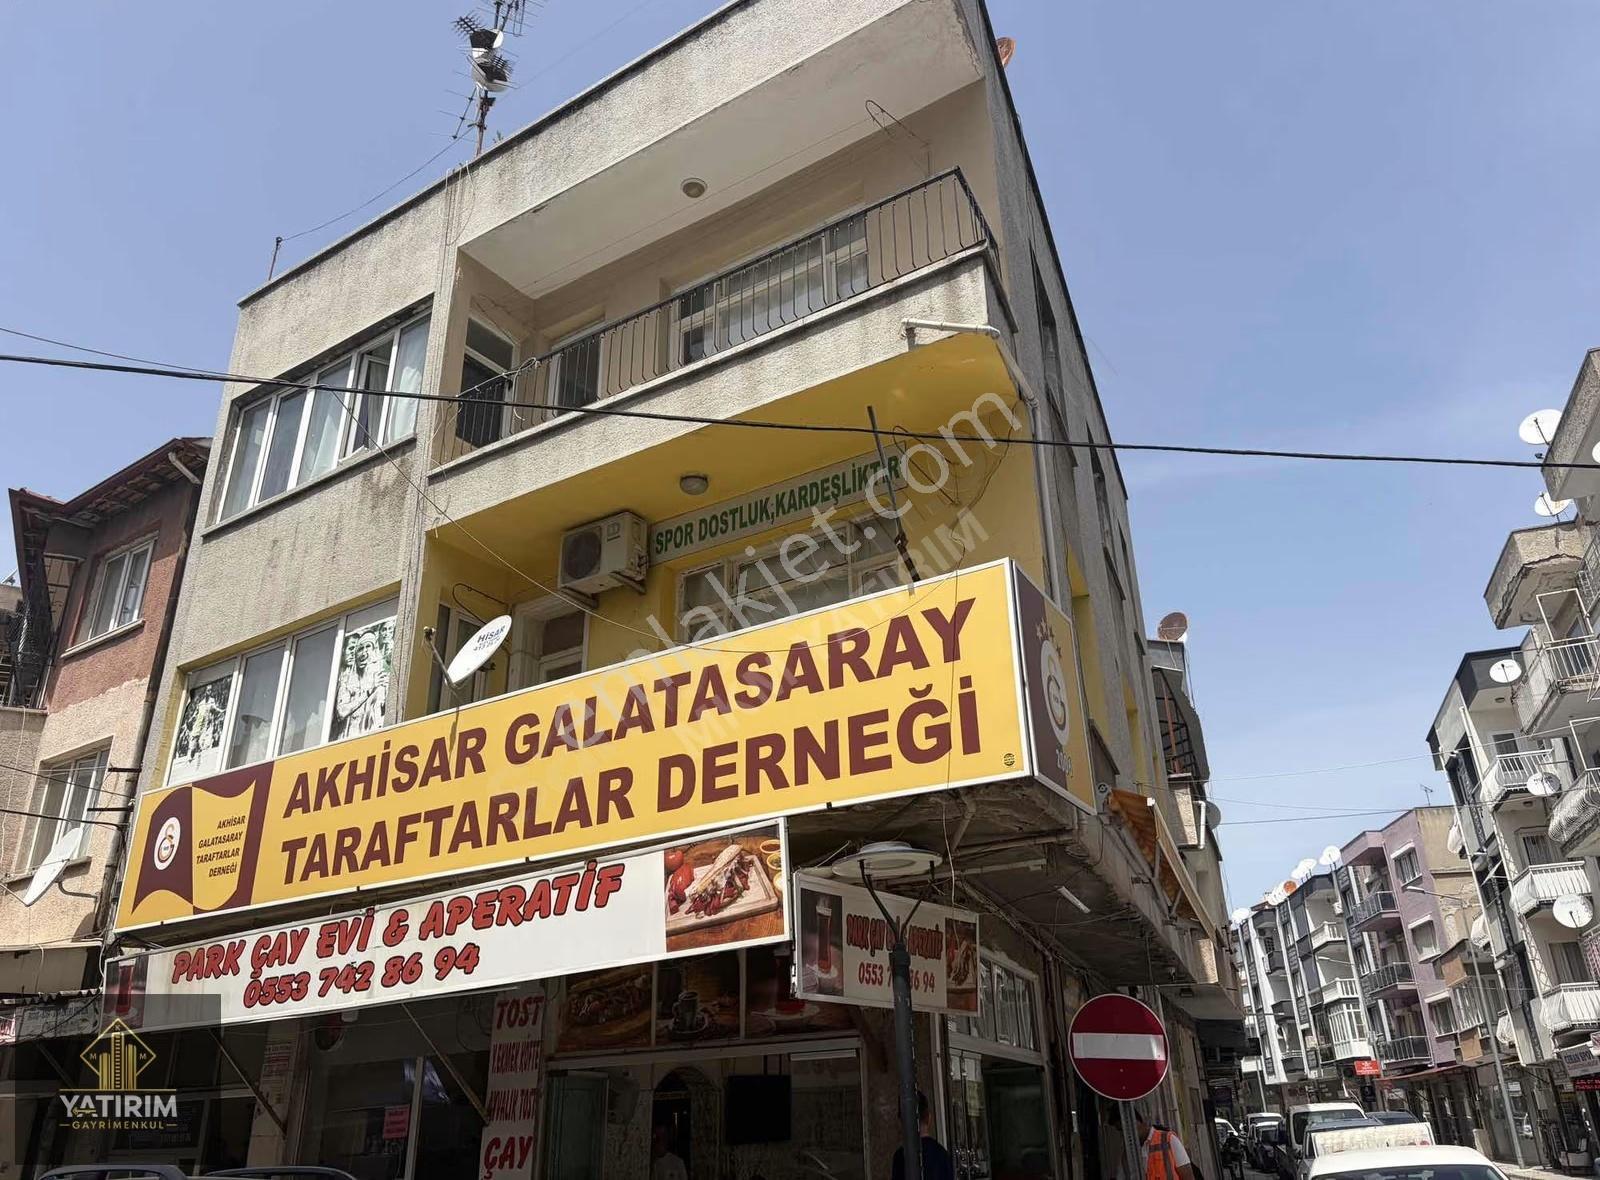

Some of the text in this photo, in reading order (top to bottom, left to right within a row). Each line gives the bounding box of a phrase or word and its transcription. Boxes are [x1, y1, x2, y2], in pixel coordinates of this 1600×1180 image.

[655, 520, 694, 555] SPOR
[283, 597, 977, 819] AKHİSAR GALATASARAY
[281, 675, 981, 885] TARAFTARLAR DERNEĞİ
[217, 815, 246, 829] AKHİSAR
[196, 847, 241, 865] TARAFTARLAR
[198, 831, 244, 849] GALATASARAY
[208, 861, 238, 878] DERNEĞİ
[171, 858, 625, 985] PARK ÇAY EVİ & APERATİF
[243, 942, 480, 1009] 0553 742 86 94
[858, 961, 884, 987] 0553
[922, 971, 936, 993] 94
[495, 995, 544, 1030] TOST
[483, 1135, 533, 1180] ÇAY
